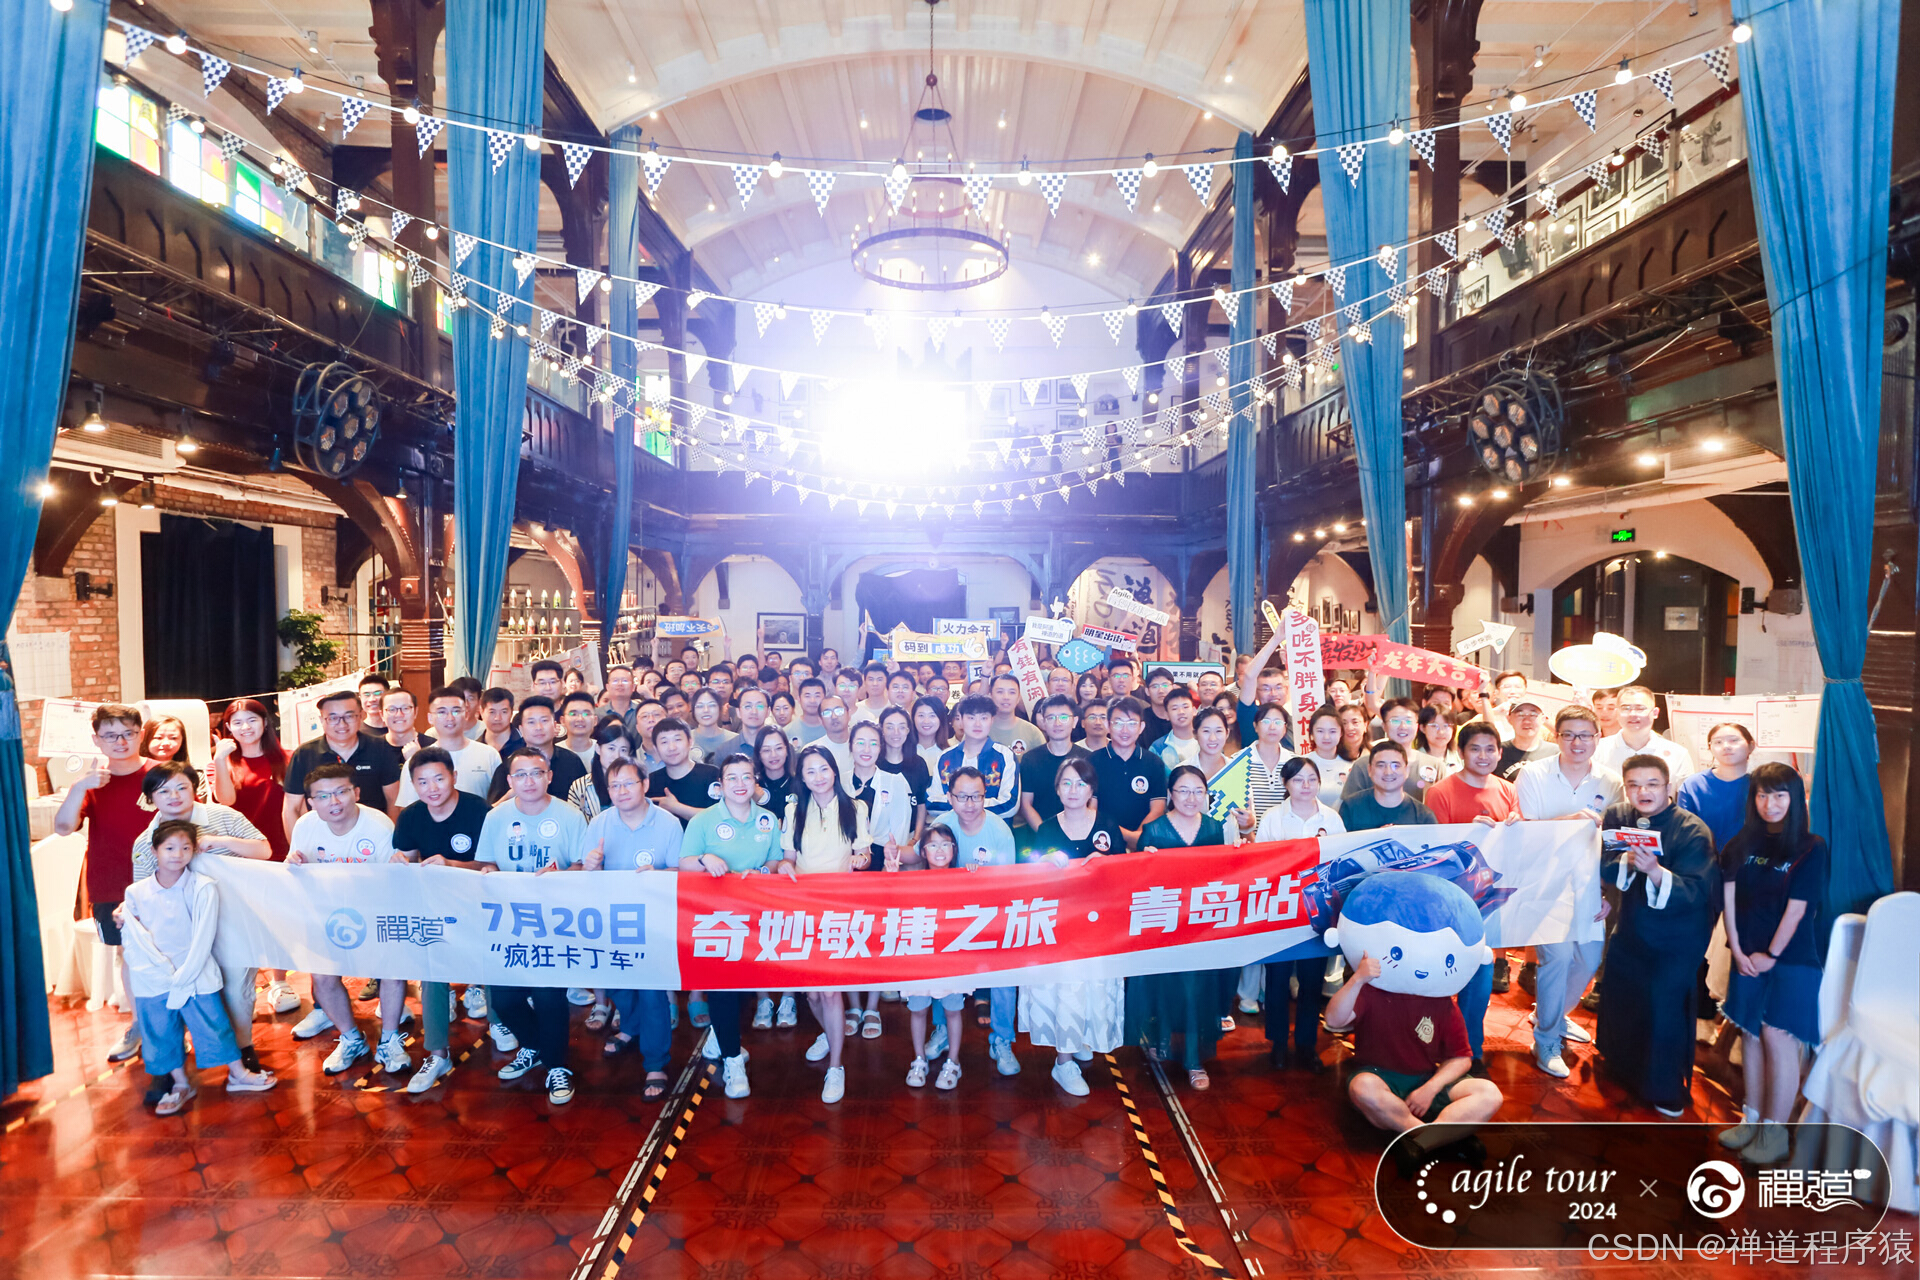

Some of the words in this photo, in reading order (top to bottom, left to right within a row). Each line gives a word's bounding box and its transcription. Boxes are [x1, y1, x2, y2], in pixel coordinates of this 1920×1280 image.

[664, 622, 716, 633] 今天不加班
[904, 641, 960, 654] 码到成功
[1383, 651, 1467, 682] 龙年大吉
[481, 901, 646, 945] 7月20日
